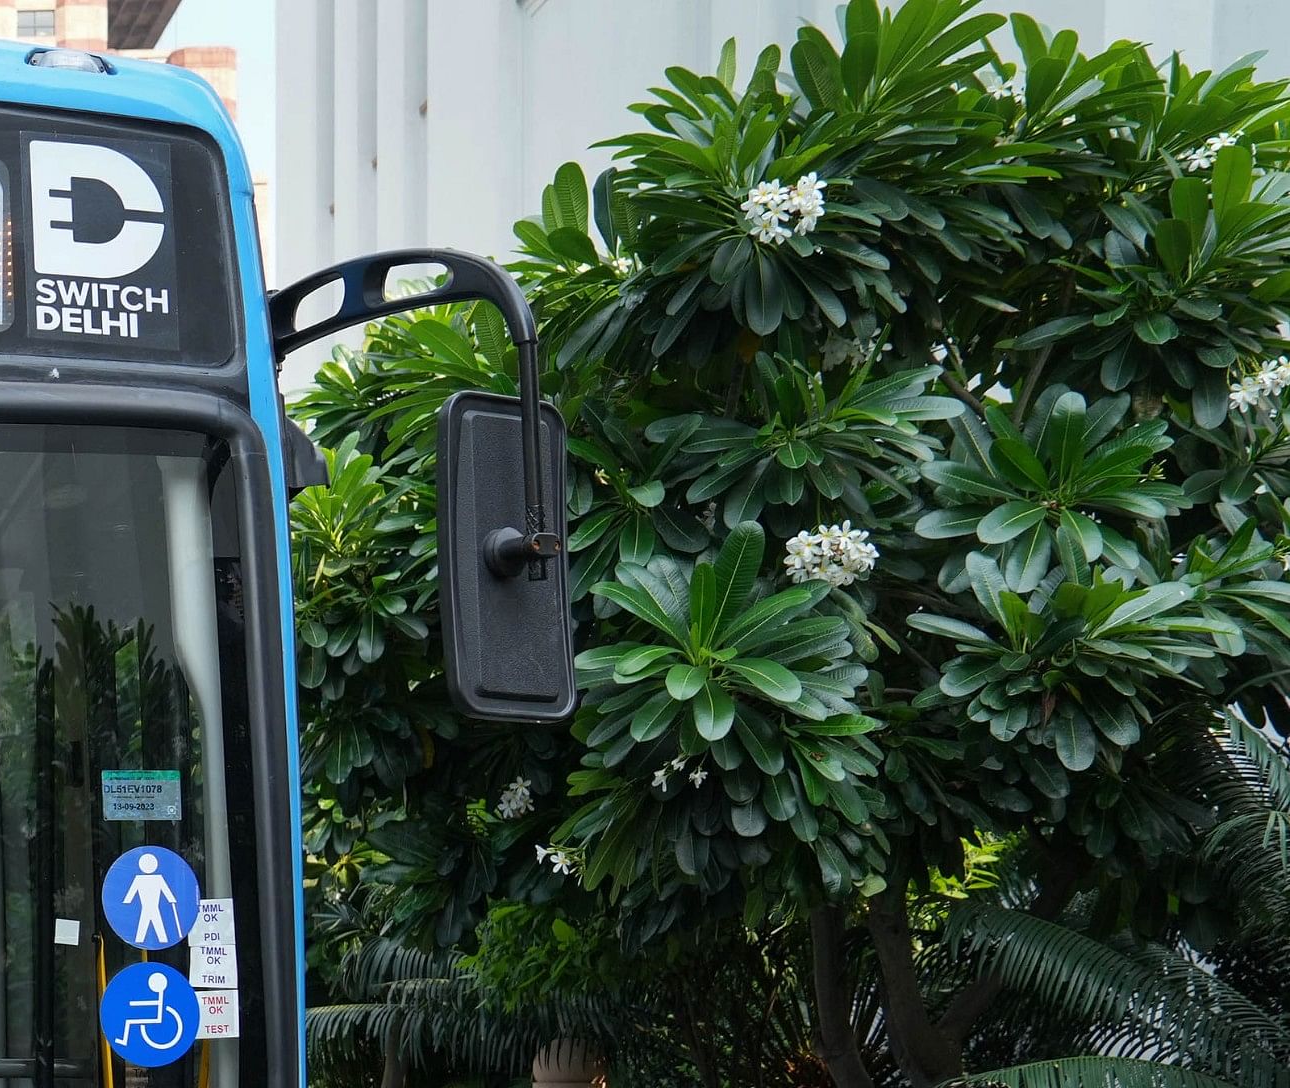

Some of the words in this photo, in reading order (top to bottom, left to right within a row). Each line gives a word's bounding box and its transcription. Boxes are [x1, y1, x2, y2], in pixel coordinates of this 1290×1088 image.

[35, 278, 169, 315] SWITCH
[35, 305, 139, 339] DELHI
[103, 784, 163, 794] DL51EV1078
[203, 913, 219, 922] OK
[204, 932, 220, 941] PDI
[200, 946, 227, 956] TMML
[206, 956, 221, 965] OK
[202, 975, 226, 984] TRIM
[201, 996, 230, 1005] TMML
[208, 1006, 223, 1015] OK
[205, 1024, 230, 1034] TEST
